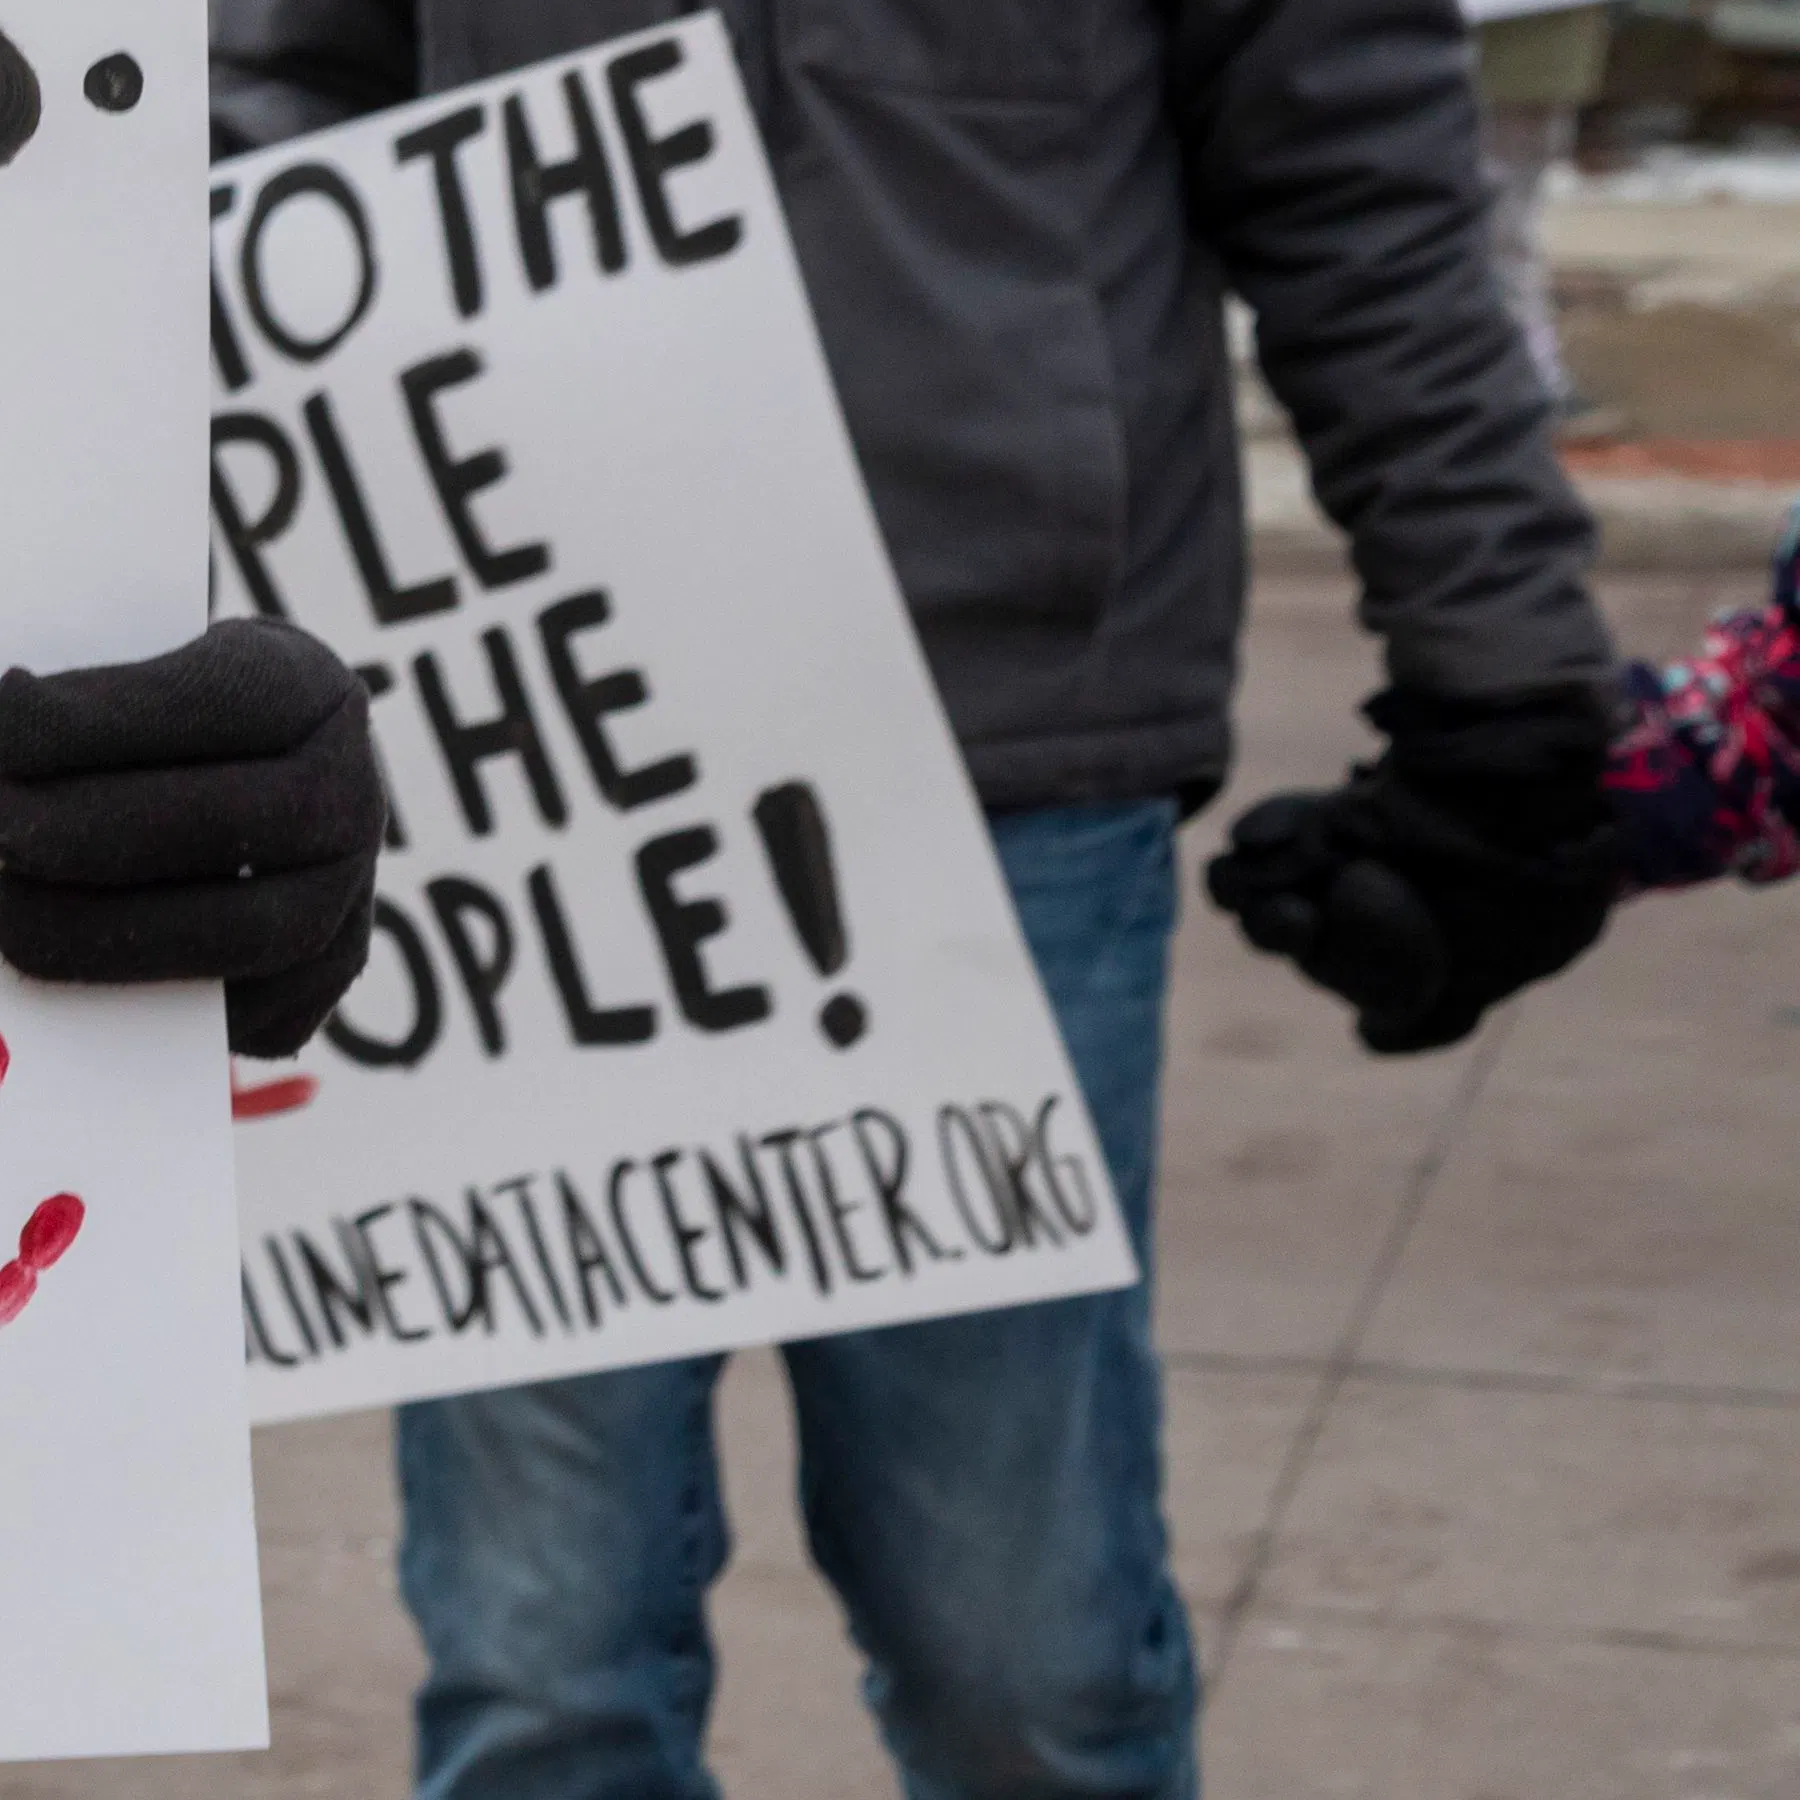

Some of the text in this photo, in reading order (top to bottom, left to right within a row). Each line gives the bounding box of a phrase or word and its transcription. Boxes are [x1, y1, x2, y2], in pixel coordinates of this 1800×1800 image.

[393, 36, 746, 321] THE
[209, 347, 554, 628] PLE
[244, 1093, 1098, 1368] LINEDATACENTER.ORG
